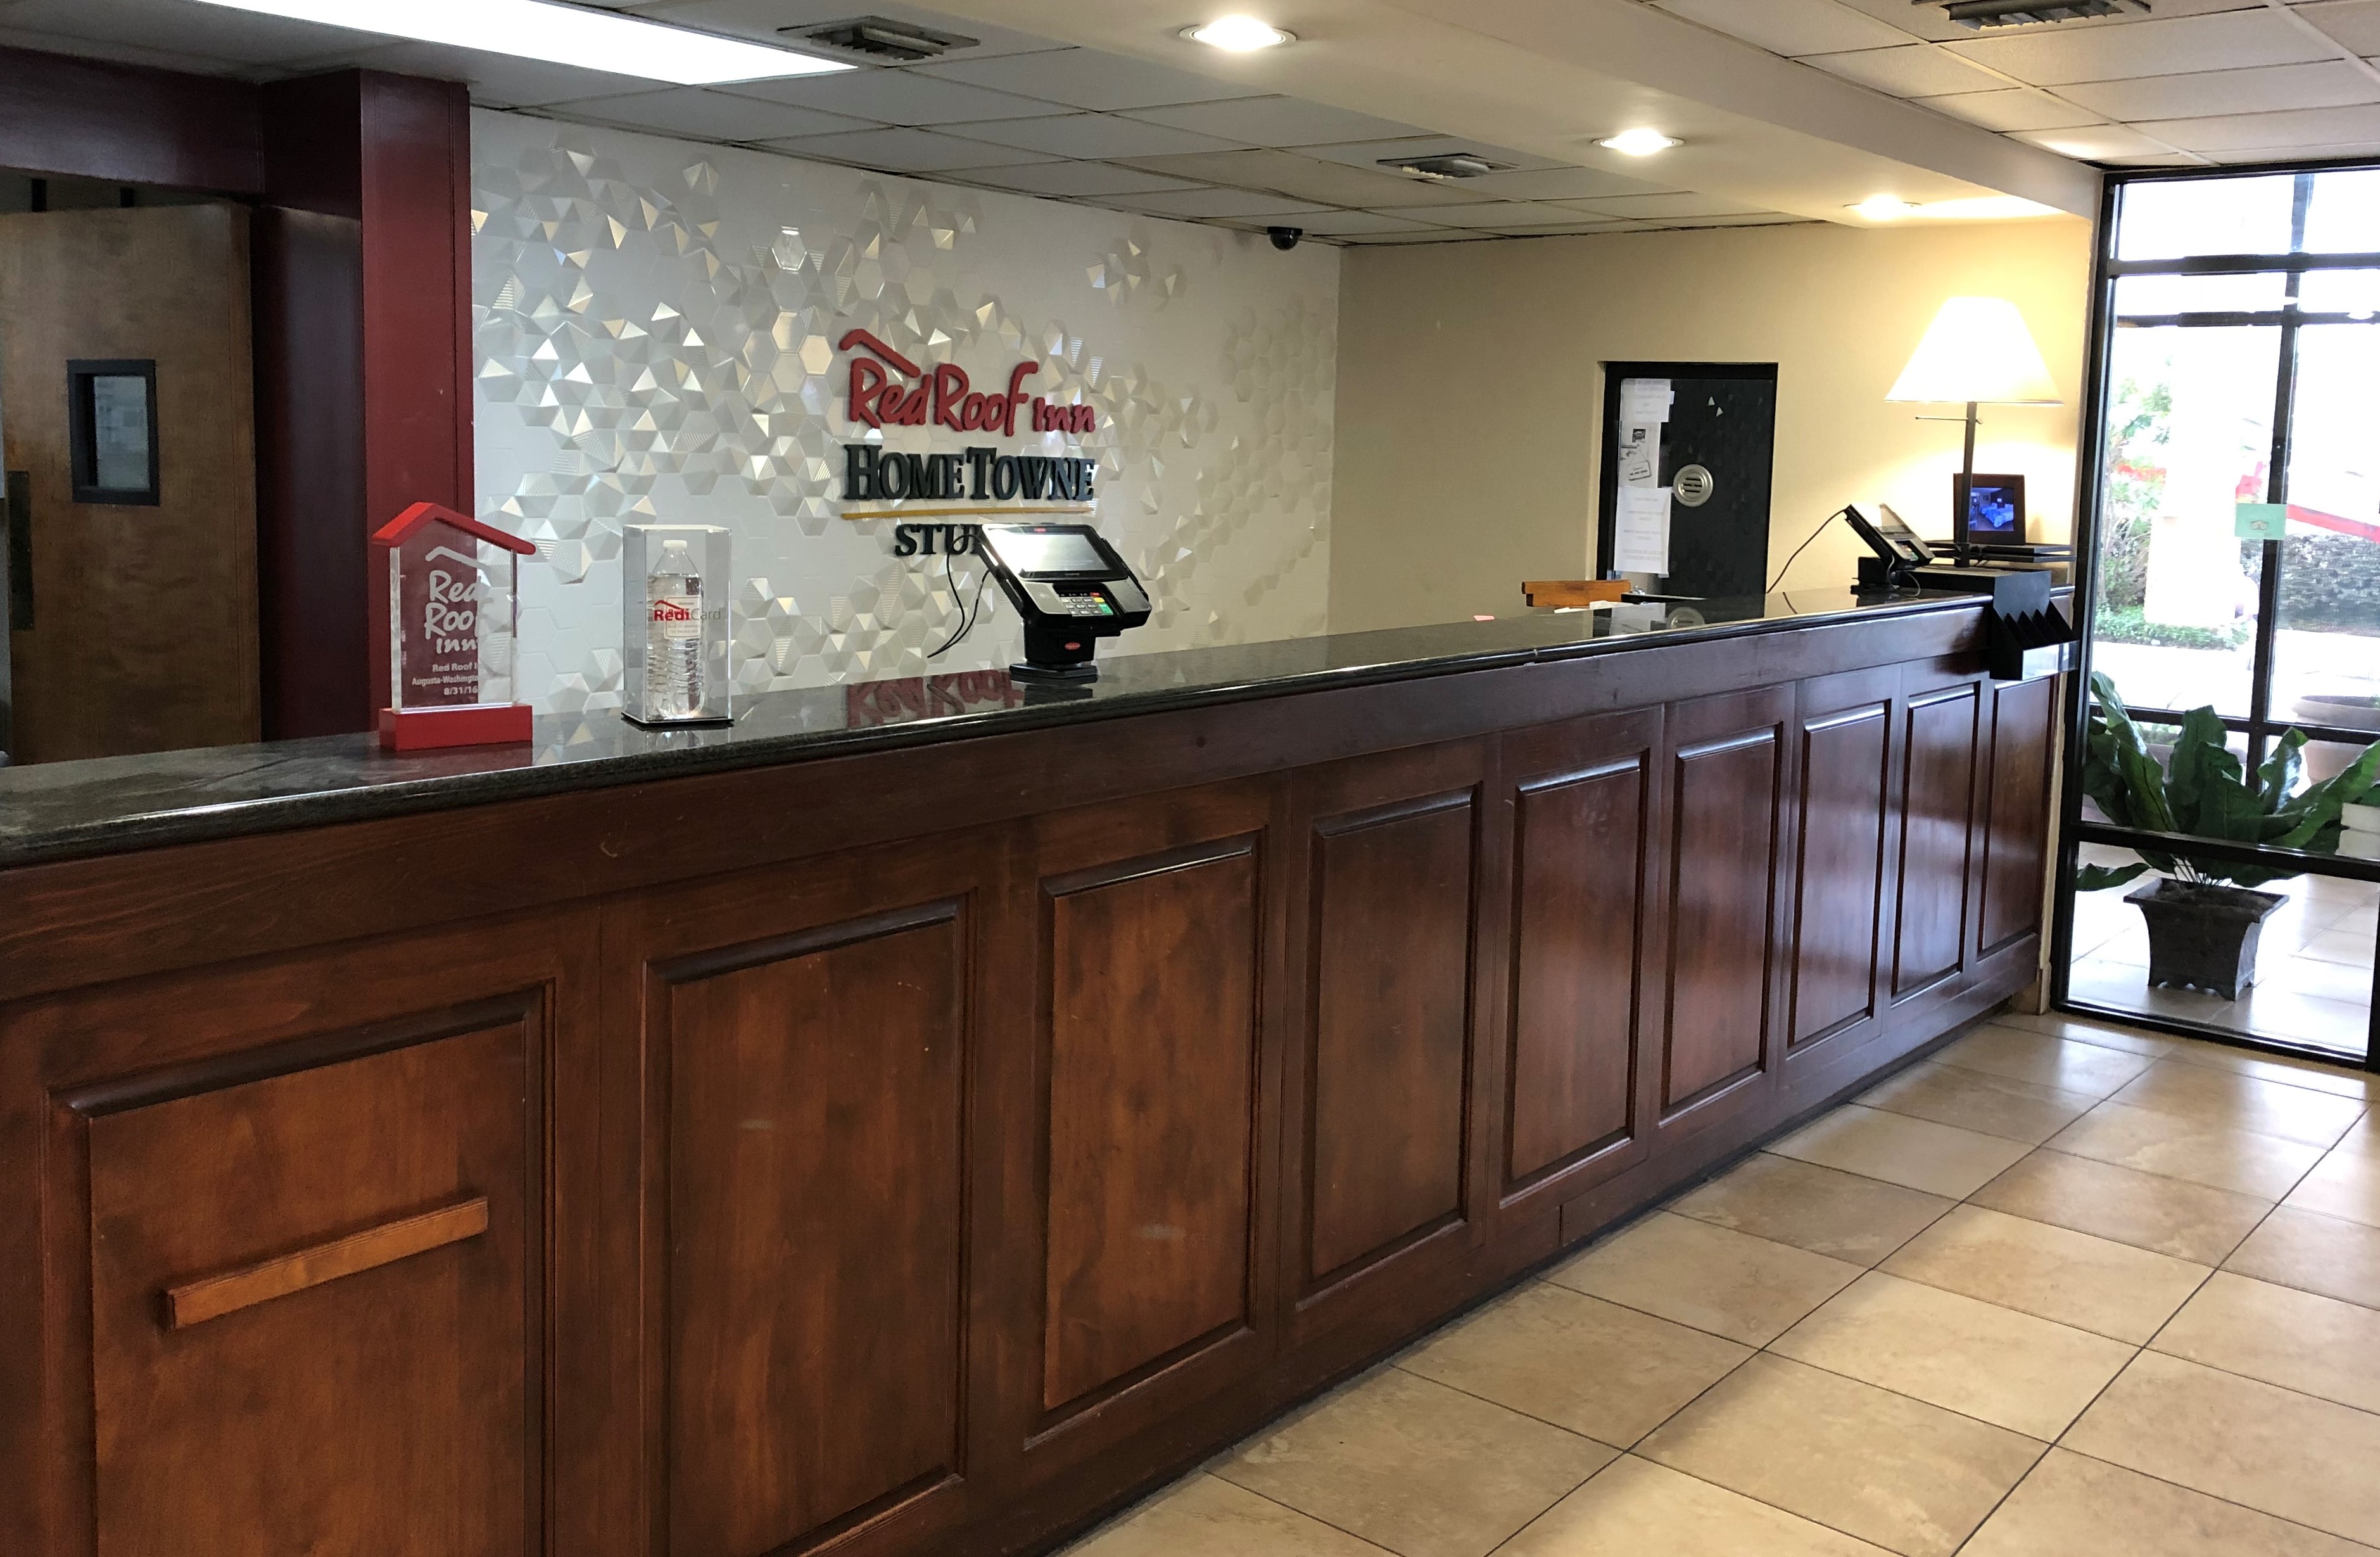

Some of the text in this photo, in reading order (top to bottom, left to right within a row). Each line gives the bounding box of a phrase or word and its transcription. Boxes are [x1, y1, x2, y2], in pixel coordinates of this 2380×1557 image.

[849, 357, 933, 429] Red
[934, 361, 1039, 437] Roof
[432, 663, 450, 672] Red
